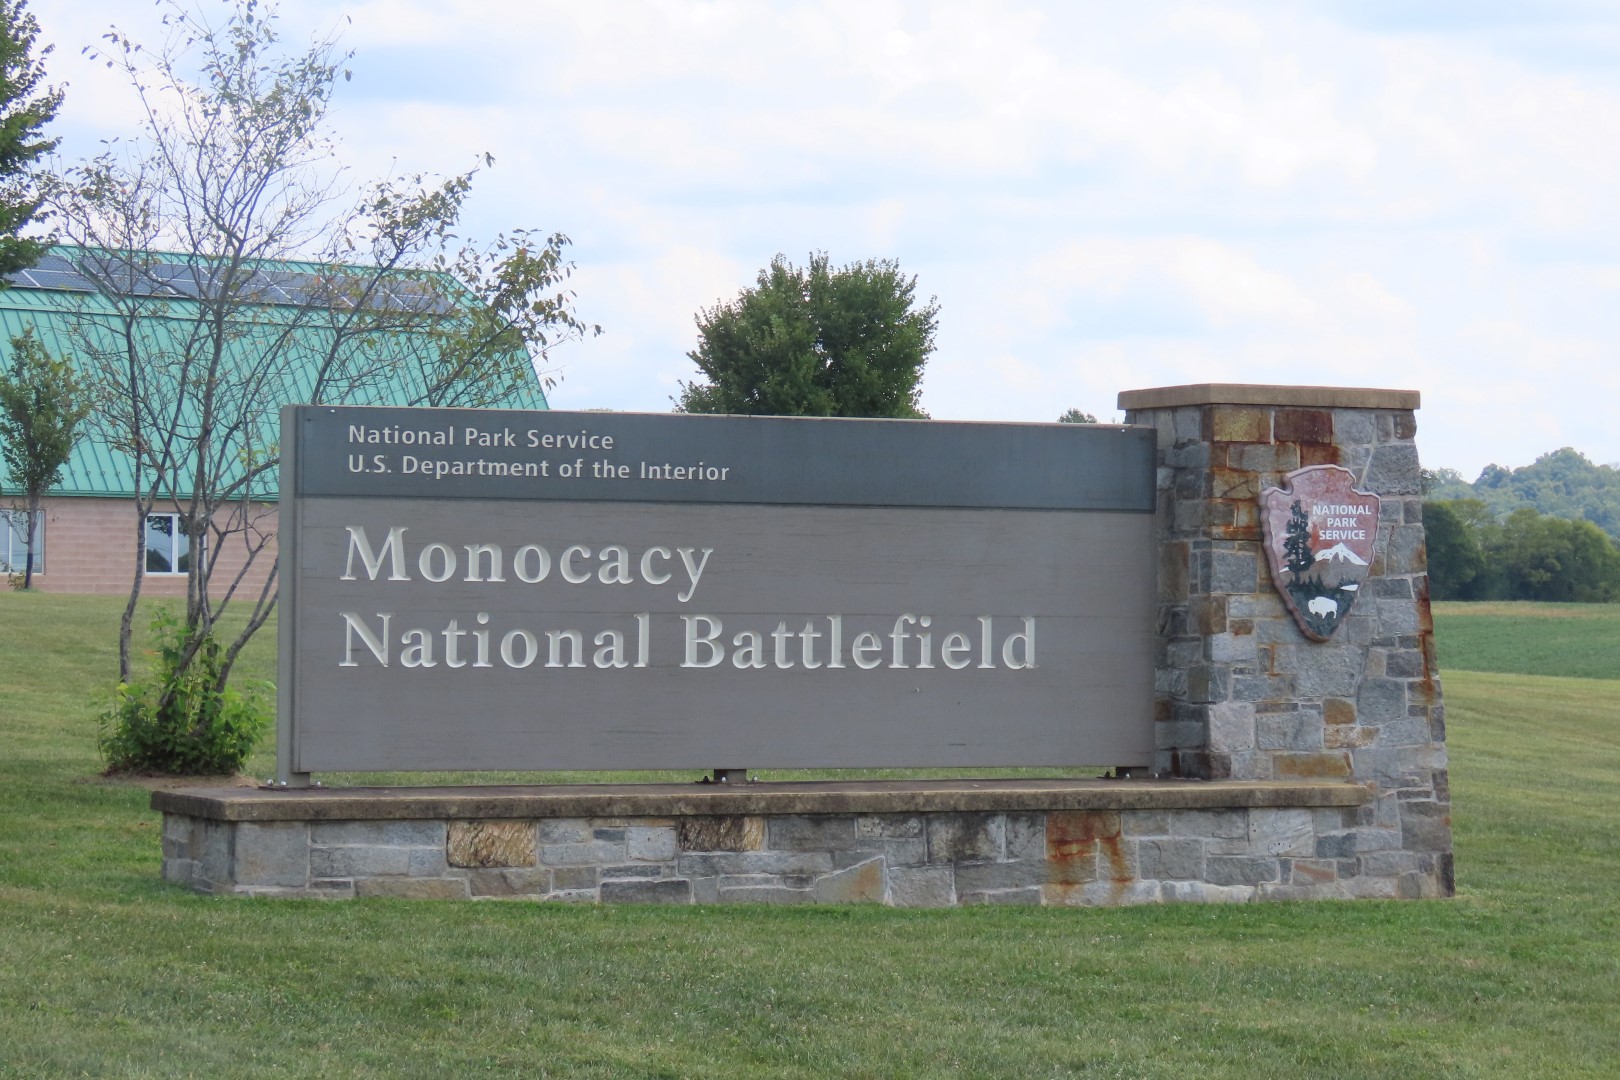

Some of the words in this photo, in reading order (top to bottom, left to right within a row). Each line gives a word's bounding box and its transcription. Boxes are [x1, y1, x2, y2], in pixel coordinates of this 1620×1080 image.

[348, 423, 455, 446] National
[464, 426, 516, 447] Park
[527, 428, 614, 450] Service
[348, 454, 392, 474] U.S.
[402, 455, 550, 480] Department
[558, 457, 585, 479] of
[592, 459, 631, 481] the
[639, 460, 731, 482] Interior
[1312, 504, 1372, 515] NATIONAL
[1327, 517, 1357, 528] PARK
[1318, 529, 1366, 540] SERVICE
[339, 526, 714, 604] Monocacy
[338, 611, 652, 670] National
[680, 612, 1038, 671] Battlefield
